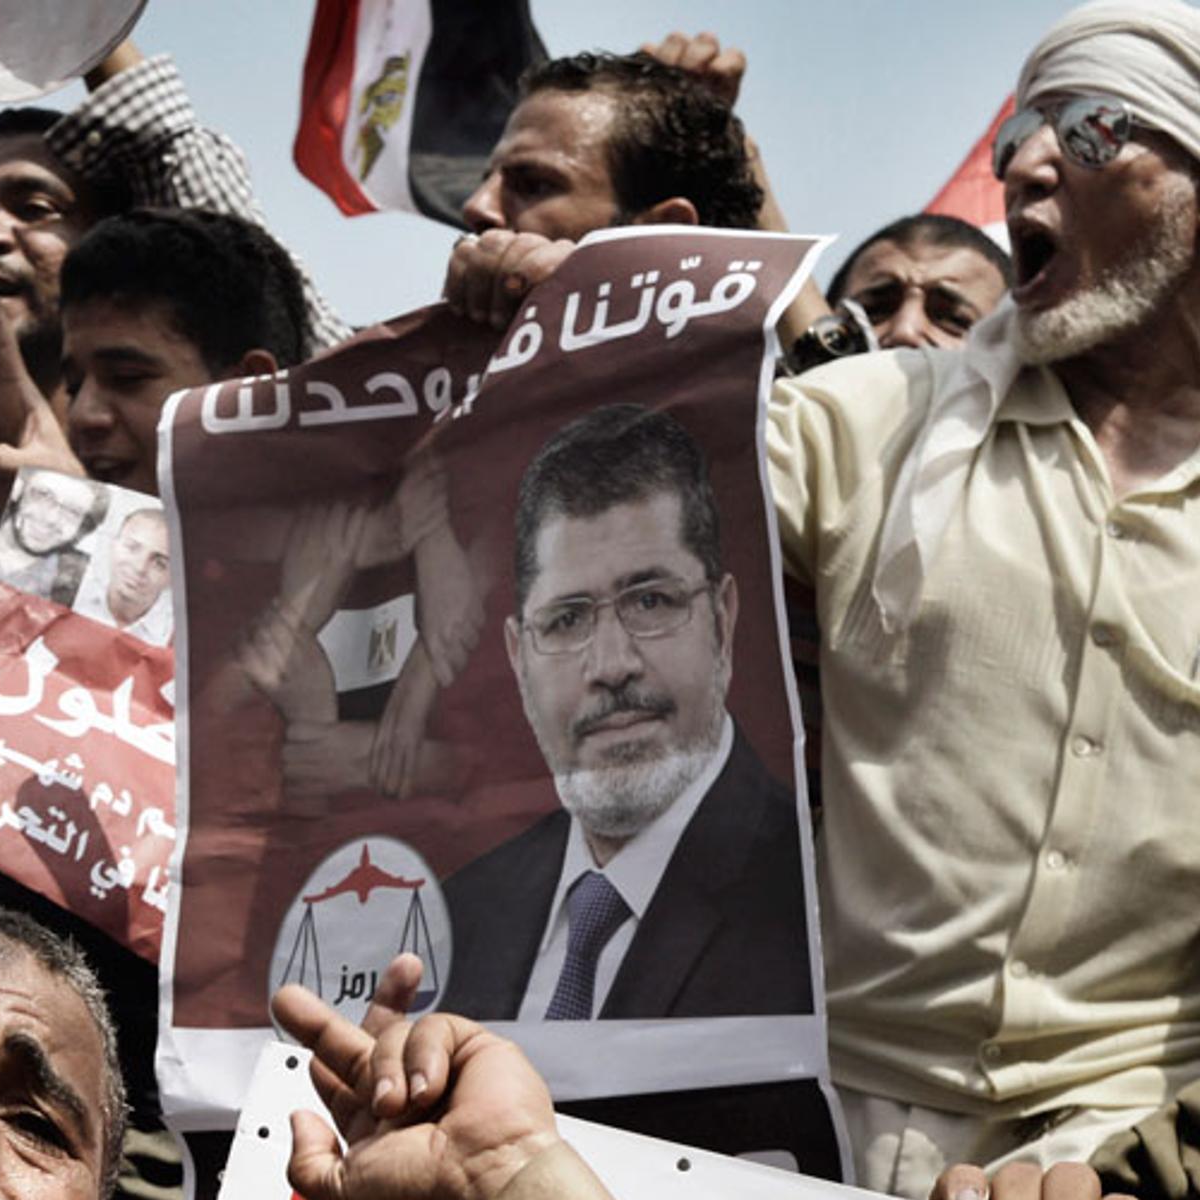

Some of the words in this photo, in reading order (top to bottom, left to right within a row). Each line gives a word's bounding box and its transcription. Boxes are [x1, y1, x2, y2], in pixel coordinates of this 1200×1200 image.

[90, 783, 133, 817] دم
[89, 845, 136, 900] في
[333, 964, 378, 1007] رمز
